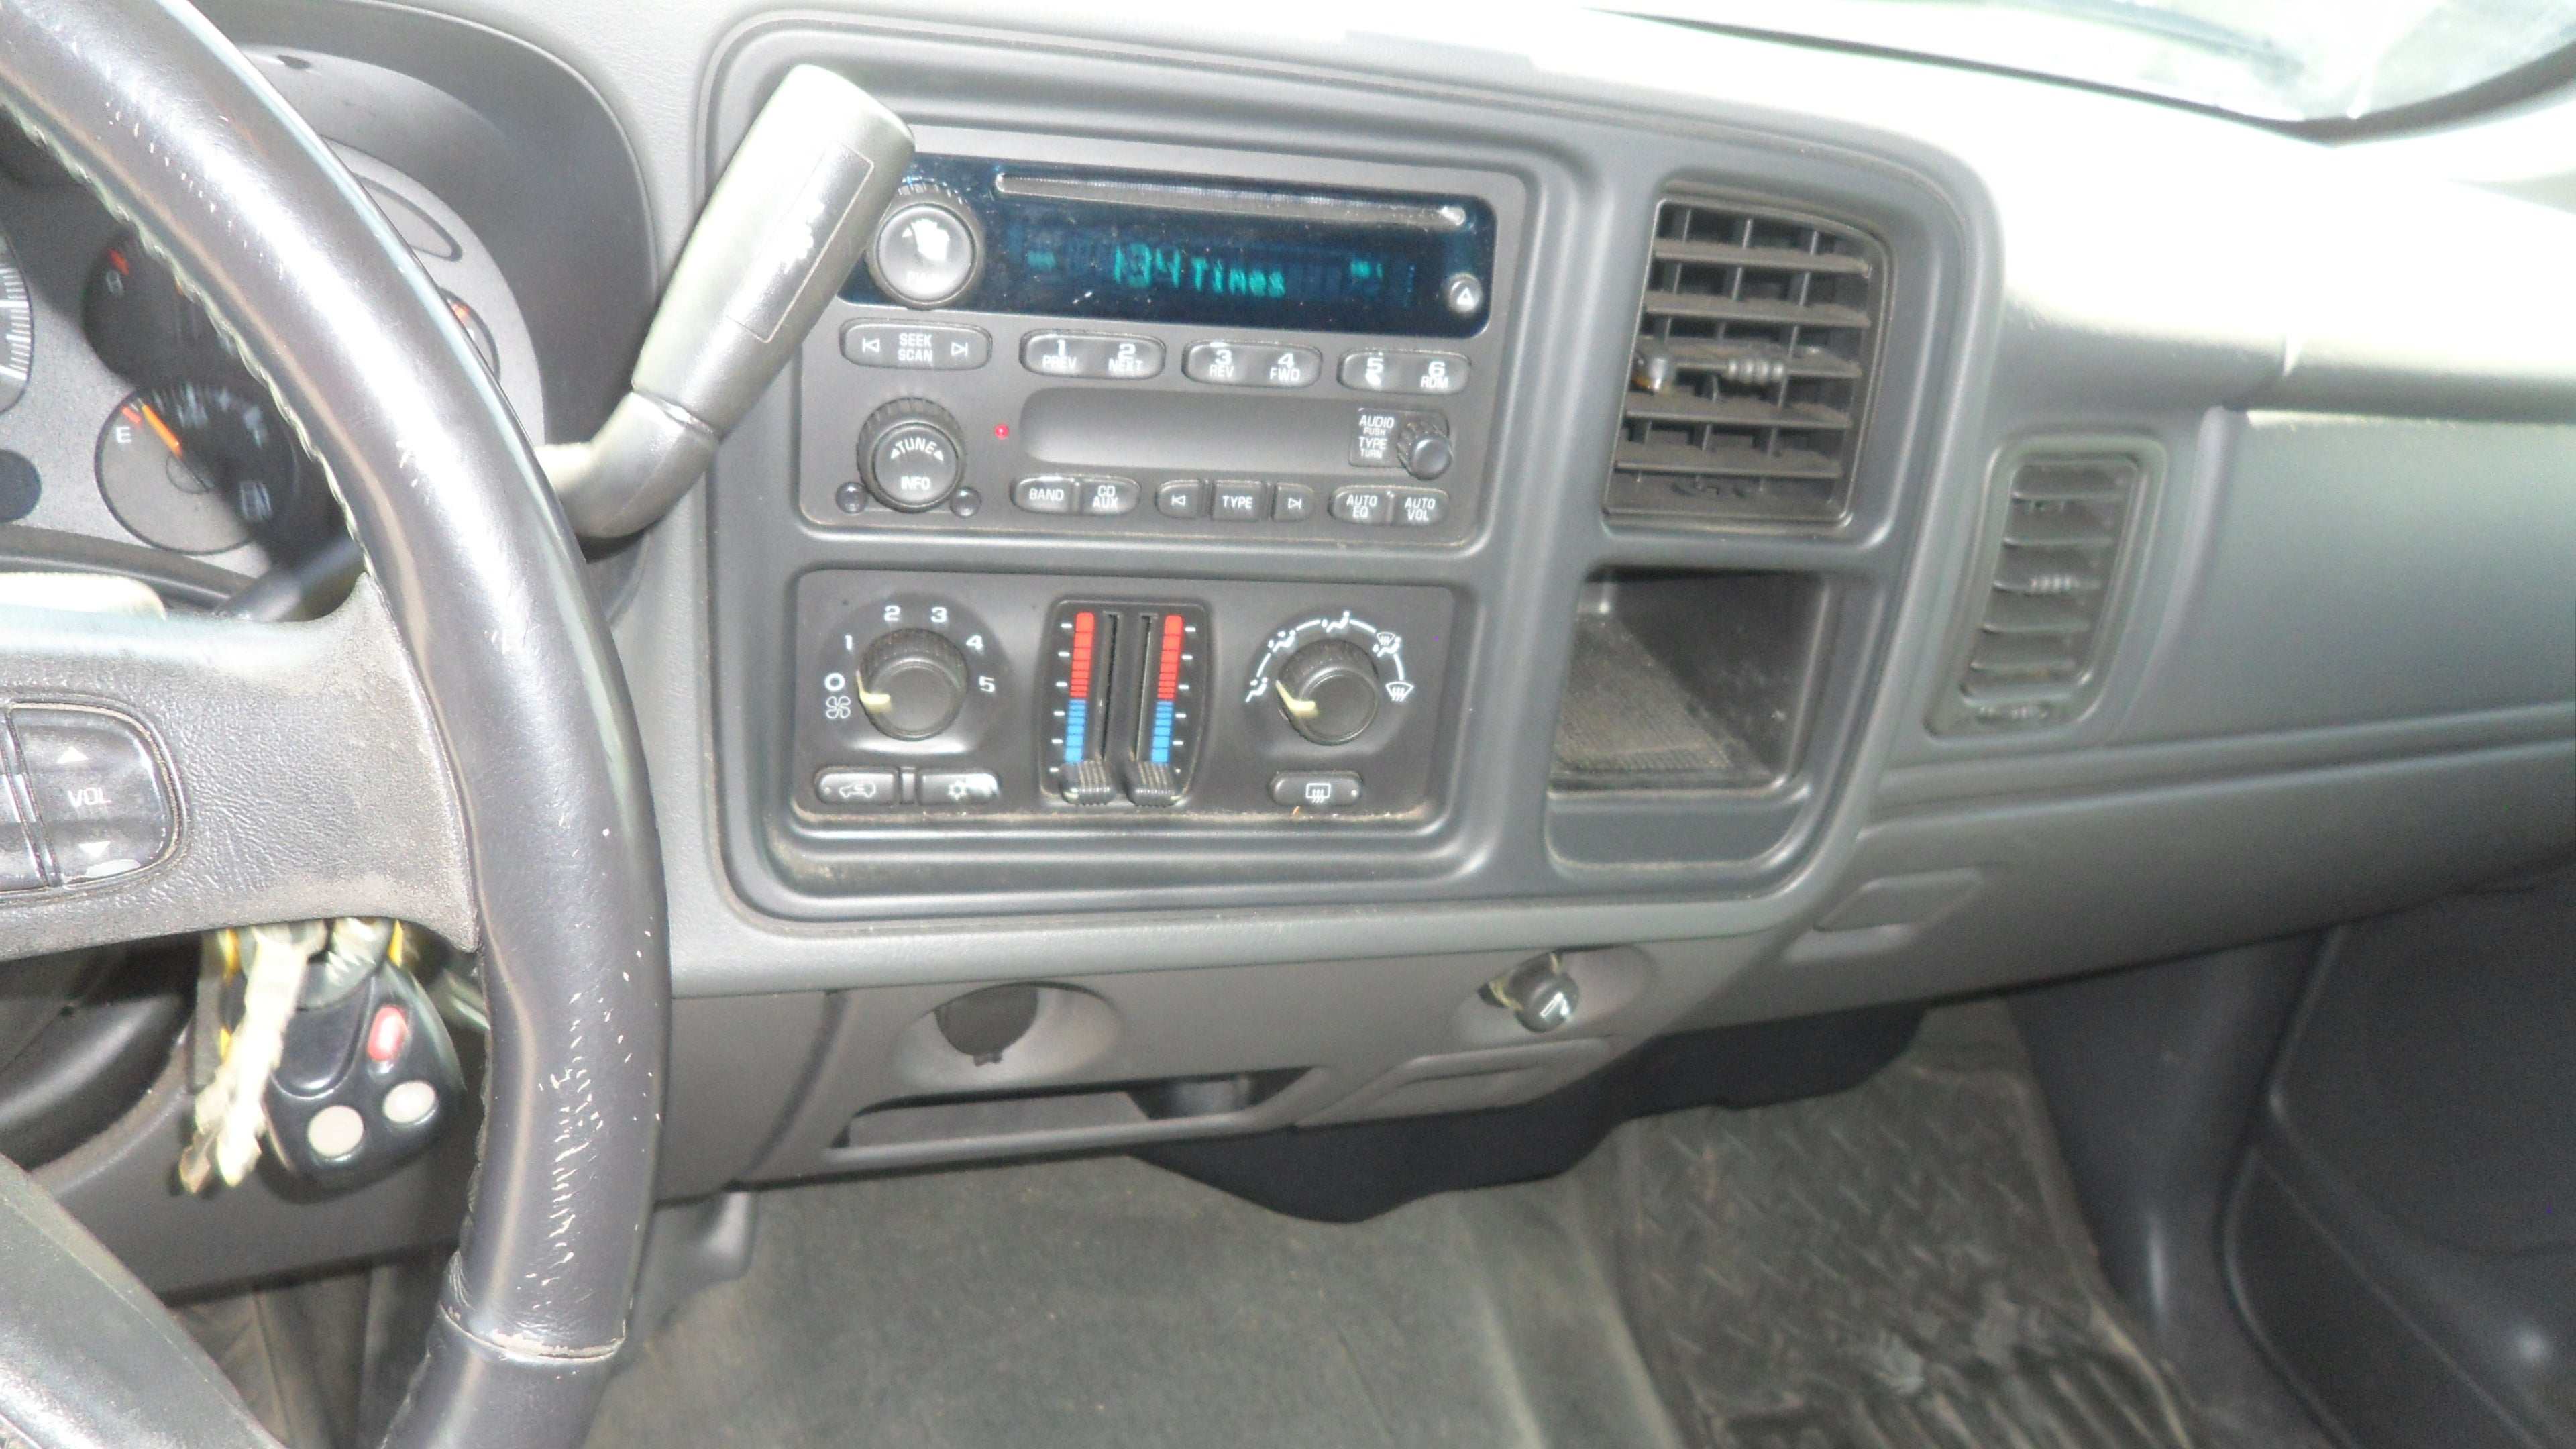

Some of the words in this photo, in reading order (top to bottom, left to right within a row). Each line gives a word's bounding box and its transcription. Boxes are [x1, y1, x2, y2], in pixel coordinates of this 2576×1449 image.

[899, 333, 932, 347] SEEK
[898, 348, 932, 362] SCAN
[1057, 339, 1066, 357] 1
[1118, 343, 1136, 360] 2
[1042, 355, 1077, 370] PREV
[1215, 350, 1232, 365] 3
[1277, 352, 1294, 368] 4
[1108, 358, 1143, 372] NEXT
[1209, 364, 1234, 377] REV
[1366, 357, 1383, 374] 5
[1428, 361, 1445, 377] 6
[1269, 367, 1300, 381] FWD
[1421, 376, 1449, 389] RDM
[1358, 415, 1395, 429] AUDIO
[115, 426, 131, 443] E
[1363, 427, 1387, 435] PUSH
[895, 437, 938, 455] TUNE
[1358, 436, 1387, 450] TYPE
[1360, 448, 1383, 459] TURN
[901, 476, 931, 490] INFO
[1029, 488, 1064, 502] BAND
[1097, 485, 1116, 498] CD
[1092, 496, 1118, 508] AUX
[1222, 495, 1253, 509] TYPE
[1346, 494, 1378, 508] AUTO
[1404, 496, 1436, 510] AUTO
[1352, 506, 1369, 519] EQ
[1407, 508, 1430, 521] VOL
[883, 605, 901, 621] 2
[930, 606, 948, 623] 3
[845, 634, 853, 651] 1
[966, 635, 983, 650] 4
[979, 676, 995, 693] 5
[67, 786, 112, 808] VOL
